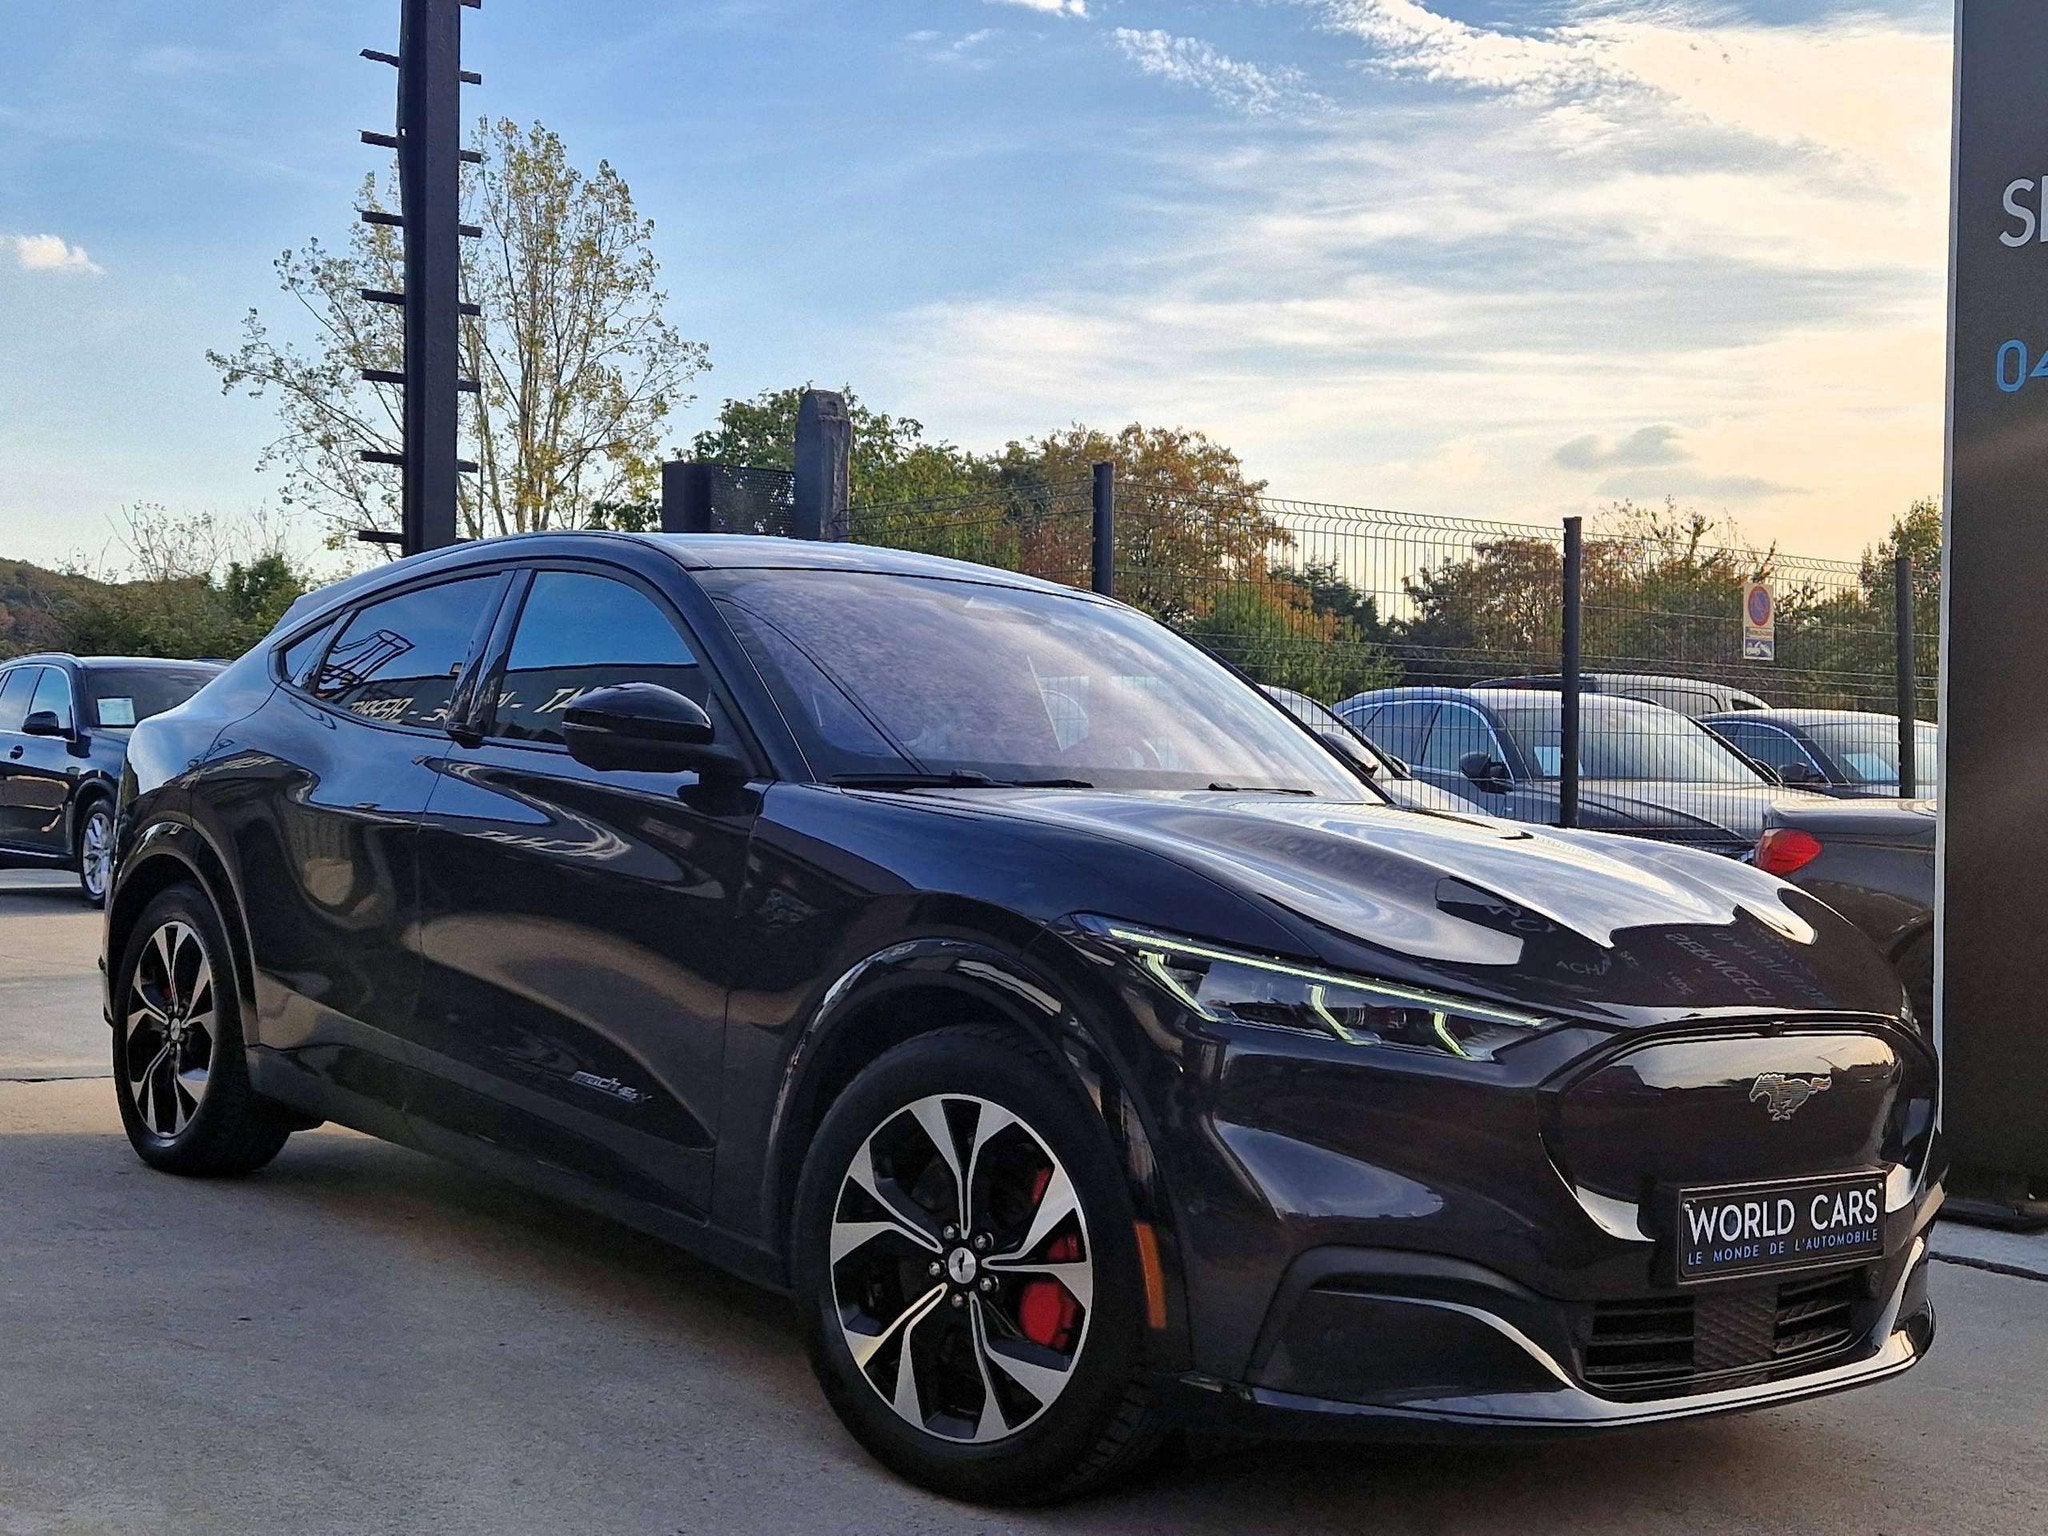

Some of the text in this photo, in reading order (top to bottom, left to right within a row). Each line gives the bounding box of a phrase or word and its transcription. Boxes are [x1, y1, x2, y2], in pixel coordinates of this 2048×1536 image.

[1999, 175, 2048, 248] S
[1688, 1188, 1878, 1246] WORLD CARS
[1687, 1228, 1879, 1266] LE MONDE DE L'AUTOMOBILE
